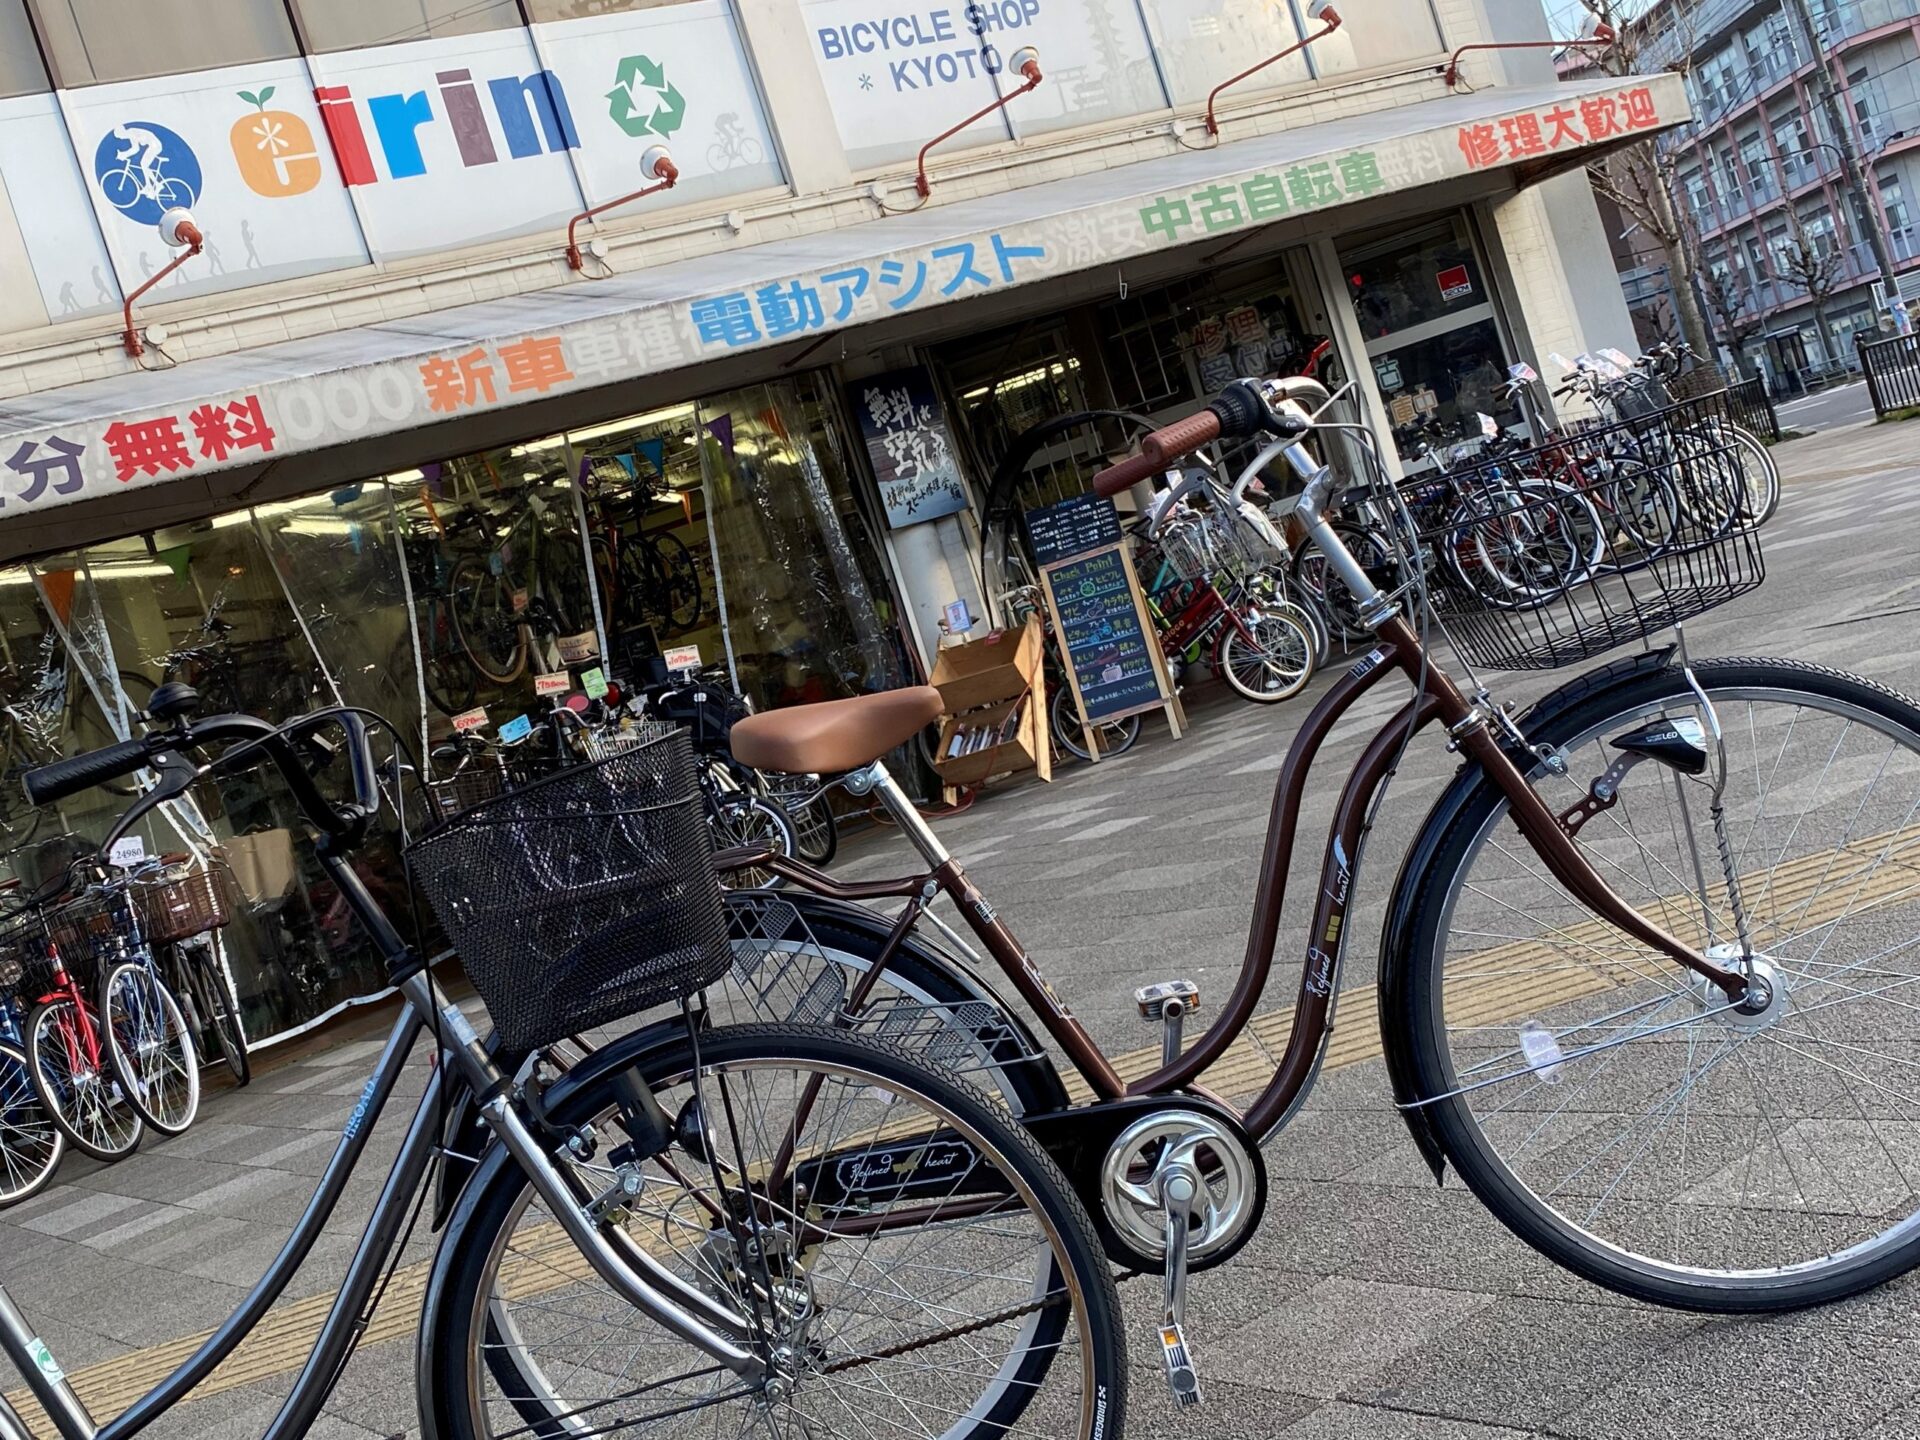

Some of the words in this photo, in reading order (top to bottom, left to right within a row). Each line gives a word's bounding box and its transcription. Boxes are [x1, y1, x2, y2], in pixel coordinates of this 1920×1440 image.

[818, 9, 957, 60] BICYCLE
[964, 0, 1041, 36] SHOP
[889, 44, 1004, 93] KYOTO
[230, 68, 581, 198] eirin
[1458, 87, 1660, 170] 修理大歓迎
[1139, 151, 1387, 242] 中古自転車
[689, 234, 1046, 348] 電動アシスト
[1443, 284, 1470, 297] SECOM
[418, 336, 575, 412] 新車
[0, 435, 87, 508] 分
[102, 394, 276, 482] 無料
[1085, 554, 1114, 573] Point
[1662, 731, 1678, 740] LED
[116, 847, 142, 860] 24980
[343, 1080, 376, 1139] BROAD
[924, 1148, 959, 1168] heart
